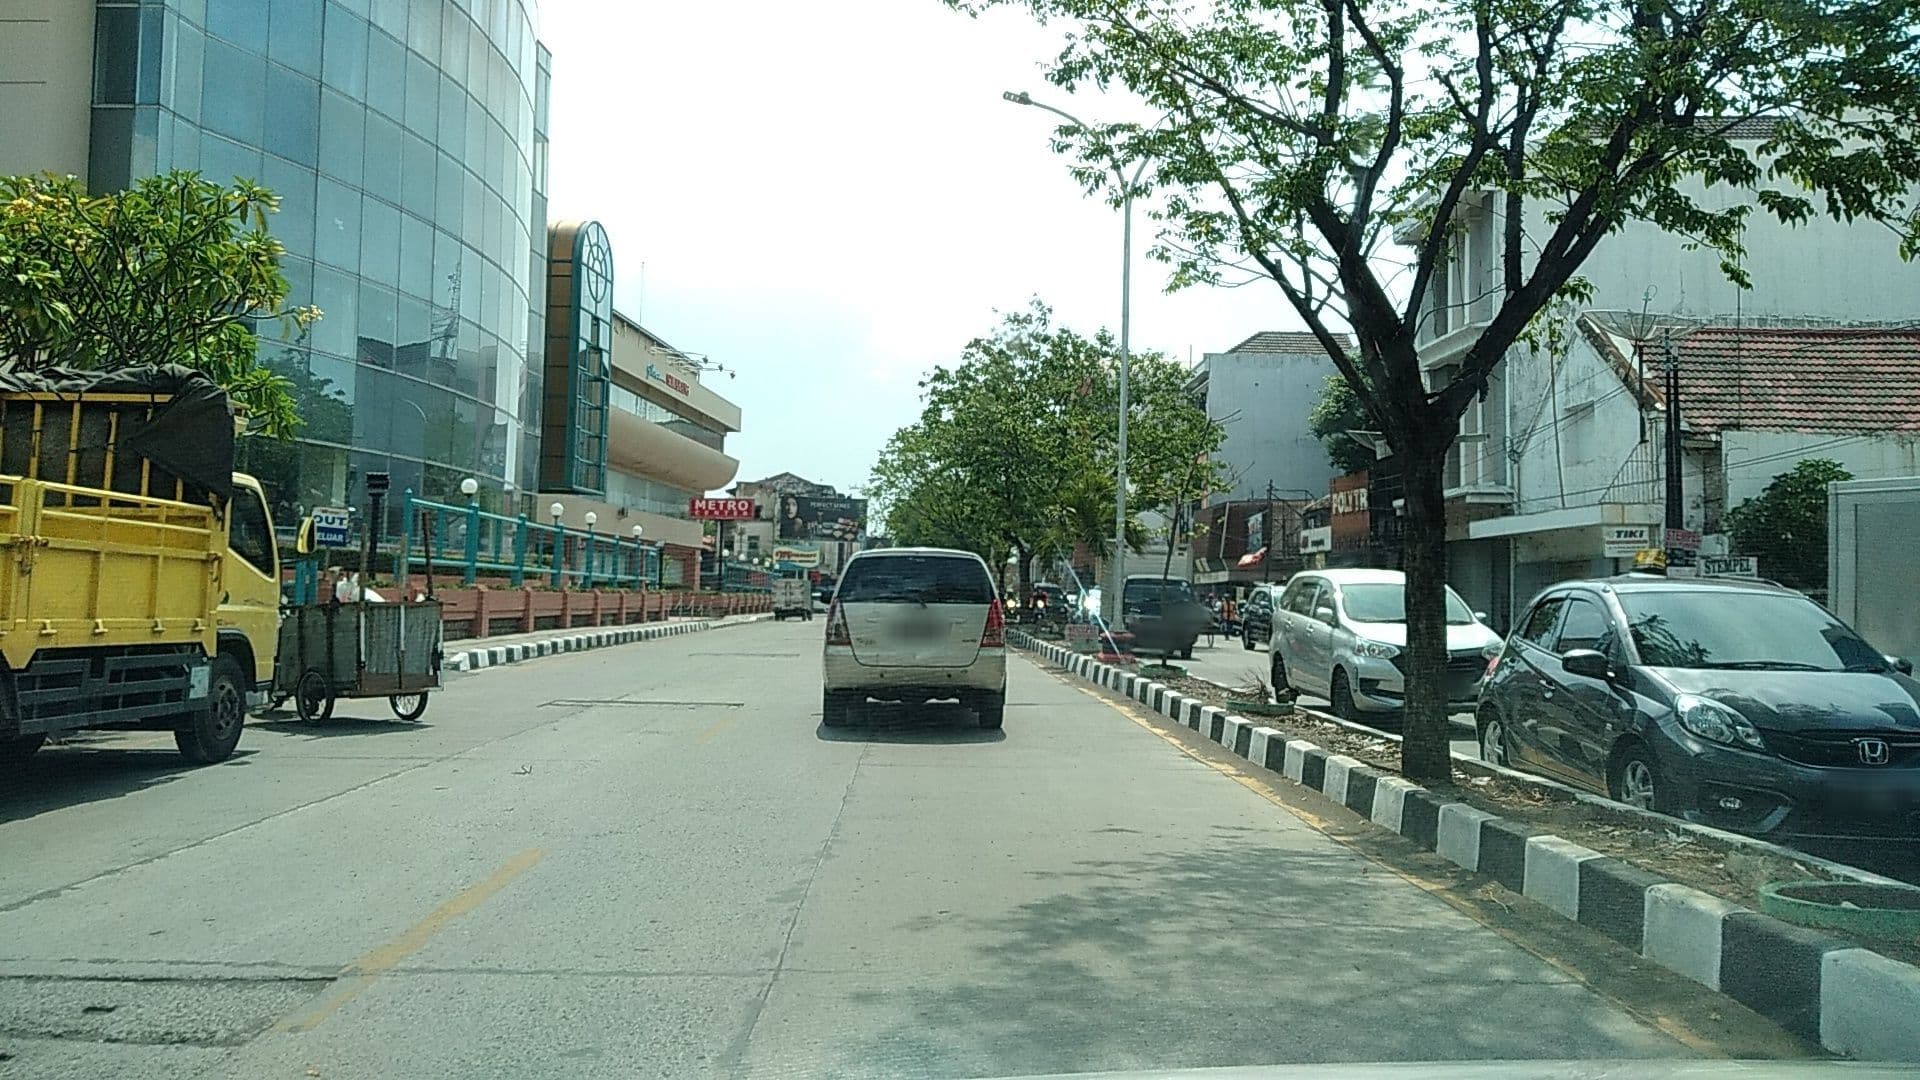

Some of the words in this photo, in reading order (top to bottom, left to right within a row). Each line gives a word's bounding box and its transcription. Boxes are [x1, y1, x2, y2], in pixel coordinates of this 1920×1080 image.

[695, 500, 749, 511] METRO
[314, 515, 347, 526] OUT
[1615, 530, 1644, 538] TIKI
[1667, 529, 1701, 541] STEMPEL
[1704, 558, 1752, 573] STEMPEL
